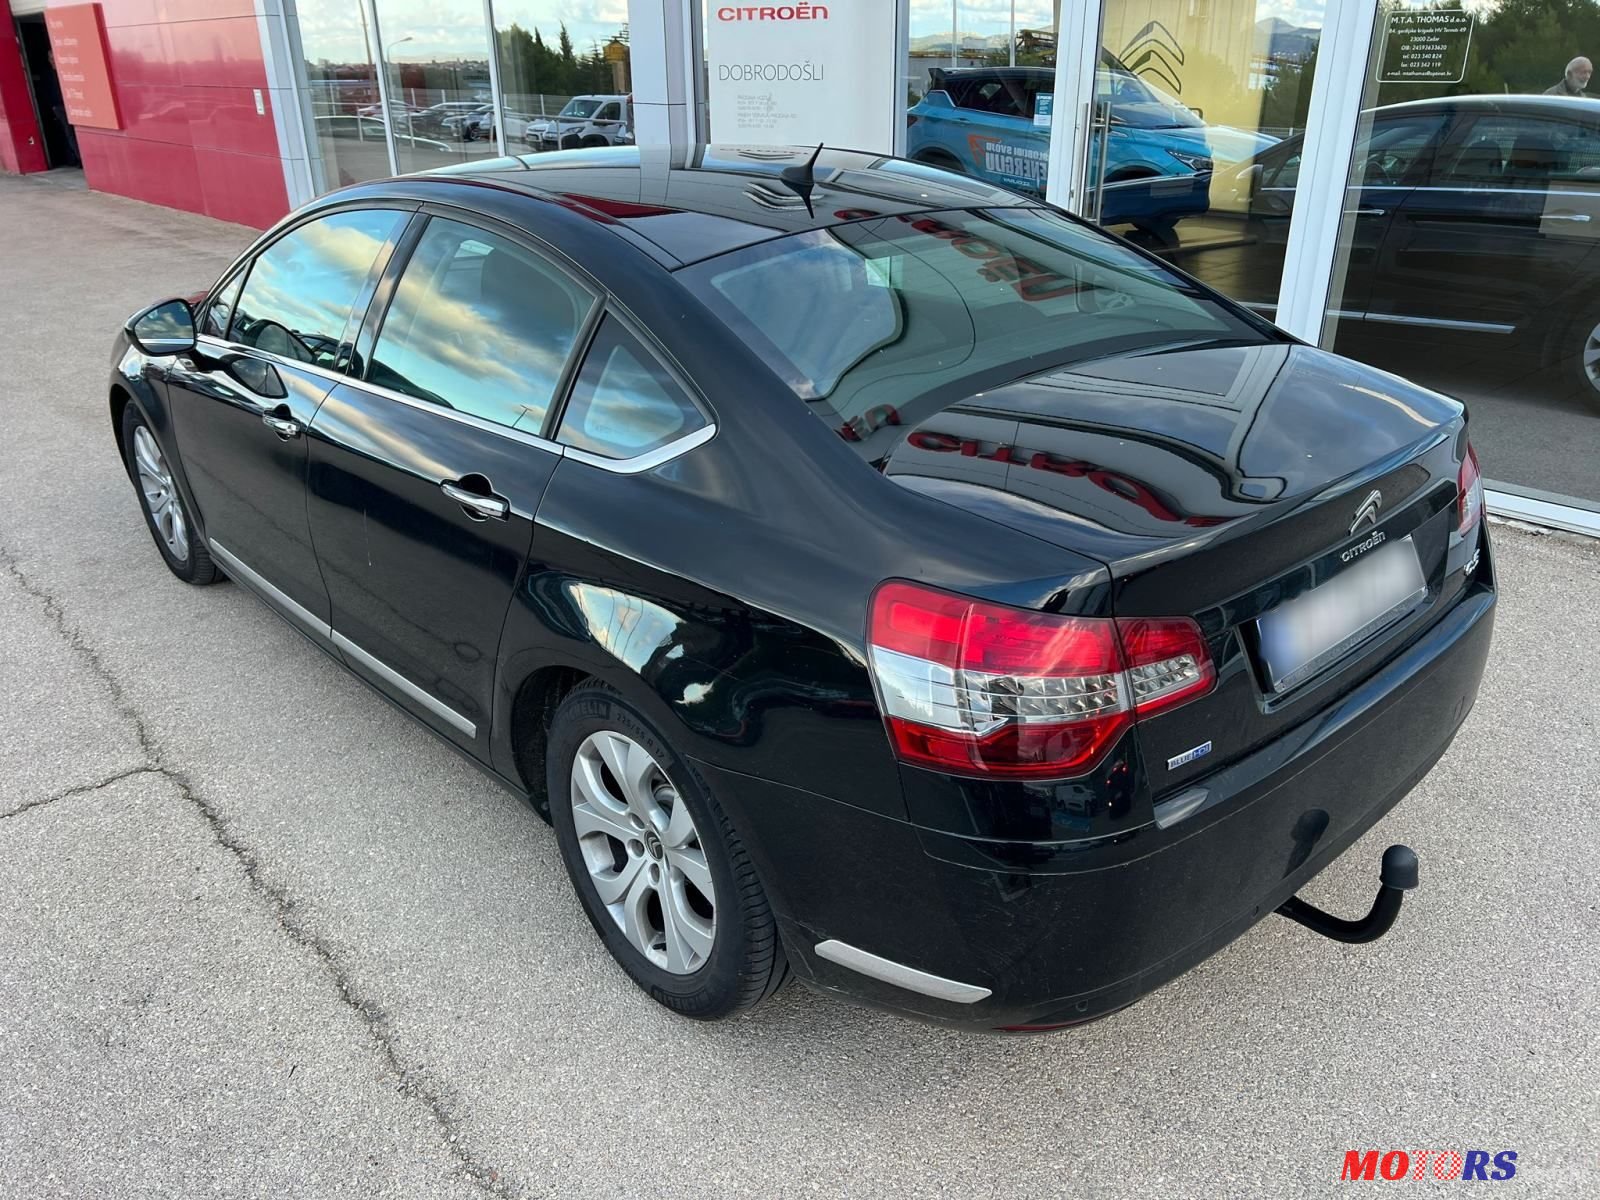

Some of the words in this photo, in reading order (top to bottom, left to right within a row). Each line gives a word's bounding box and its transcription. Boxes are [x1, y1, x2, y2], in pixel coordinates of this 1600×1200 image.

[1391, 16, 1414, 24] M.T.A.
[1417, 15, 1449, 23] THOMAS
[719, 60, 824, 81] DOBRODOŠLI
